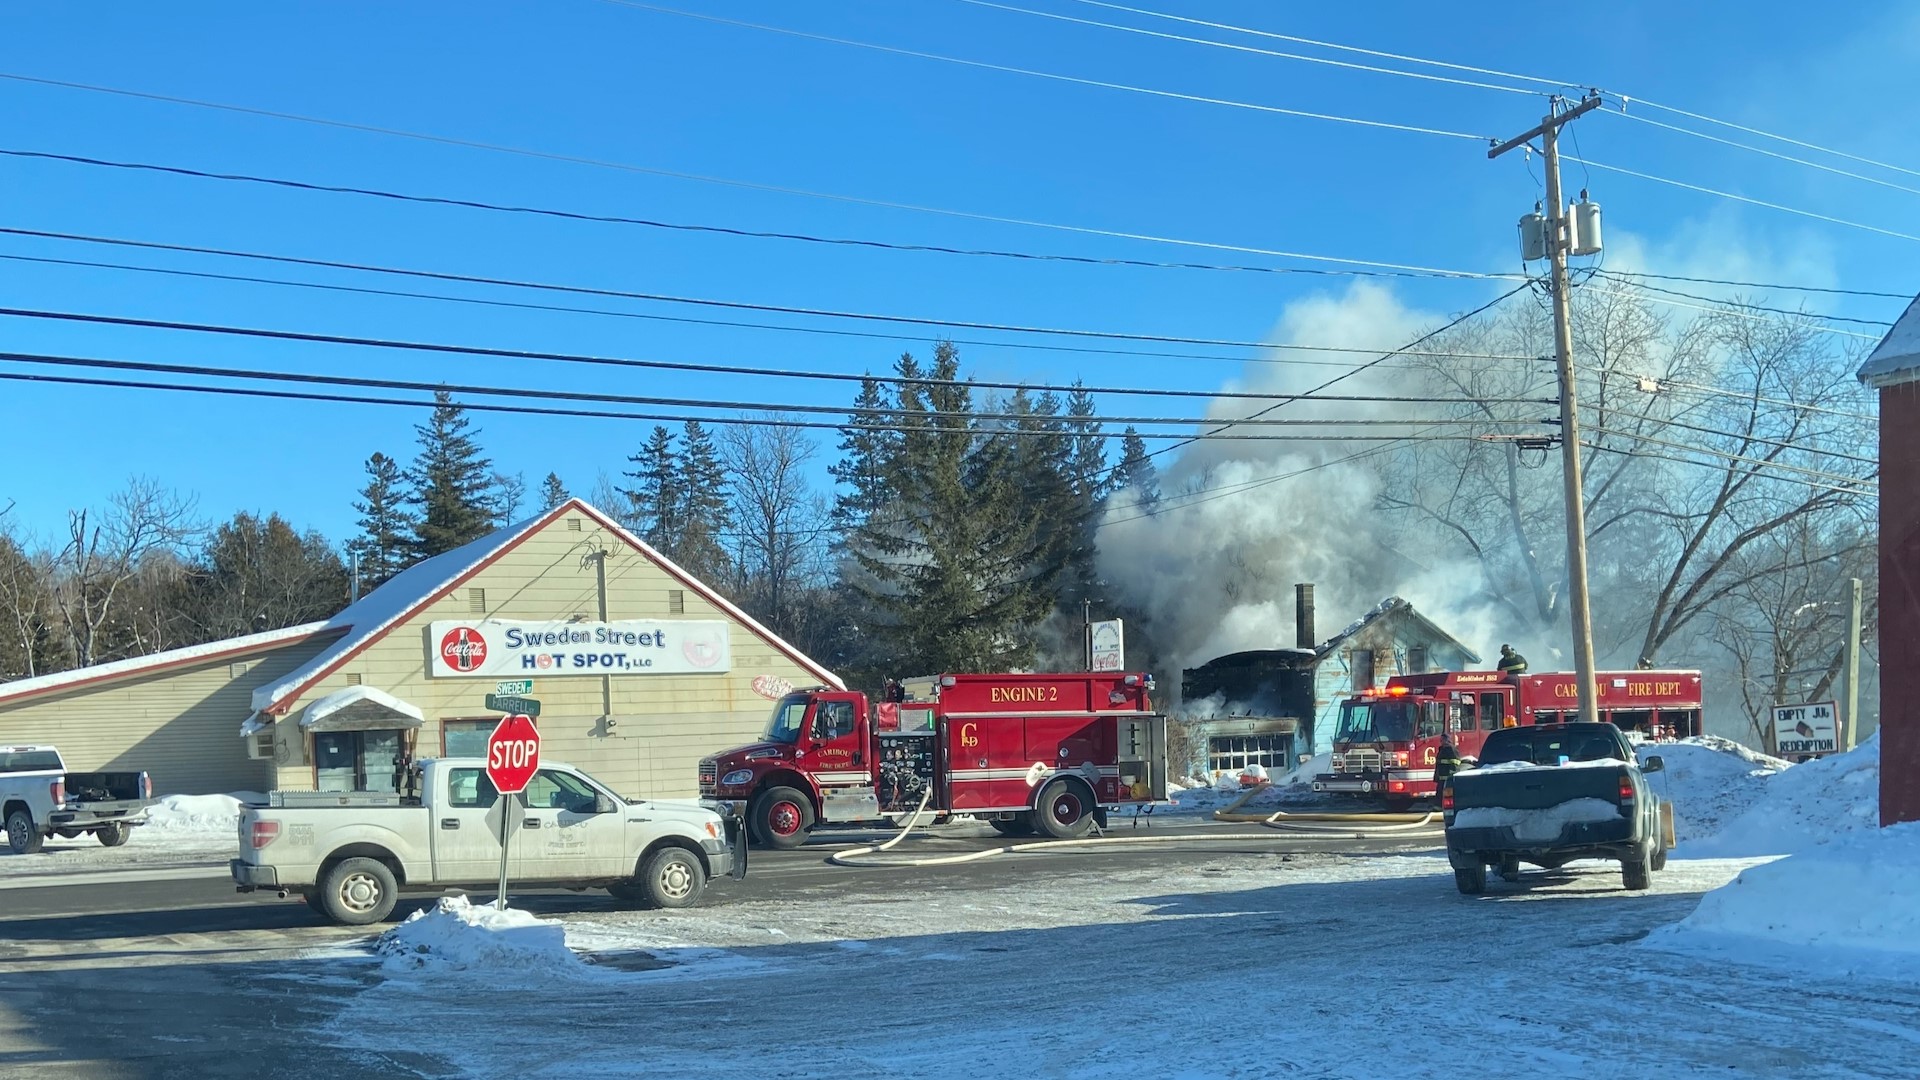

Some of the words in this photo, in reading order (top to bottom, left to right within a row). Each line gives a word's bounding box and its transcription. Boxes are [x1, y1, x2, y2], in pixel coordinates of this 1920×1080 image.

[505, 627, 592, 649] Sweden
[595, 626, 665, 649] Street
[521, 653, 565, 669] HOT
[573, 652, 631, 670] SPOT,
[633, 658, 652, 667] LLC
[497, 682, 527, 695] SWEDEN
[991, 687, 1047, 702] ENGINE
[1049, 686, 1058, 701] 2
[1554, 683, 1606, 698] CARU
[1628, 682, 1653, 696] FIRE
[1655, 682, 1681, 696] DEPT.
[492, 697, 529, 714] FARRELL
[1778, 708, 1806, 721] EMPTY
[817, 749, 851, 758] CARIBOU
[1779, 740, 1834, 753] REDEMPTION
[491, 740, 537, 770] STOP
